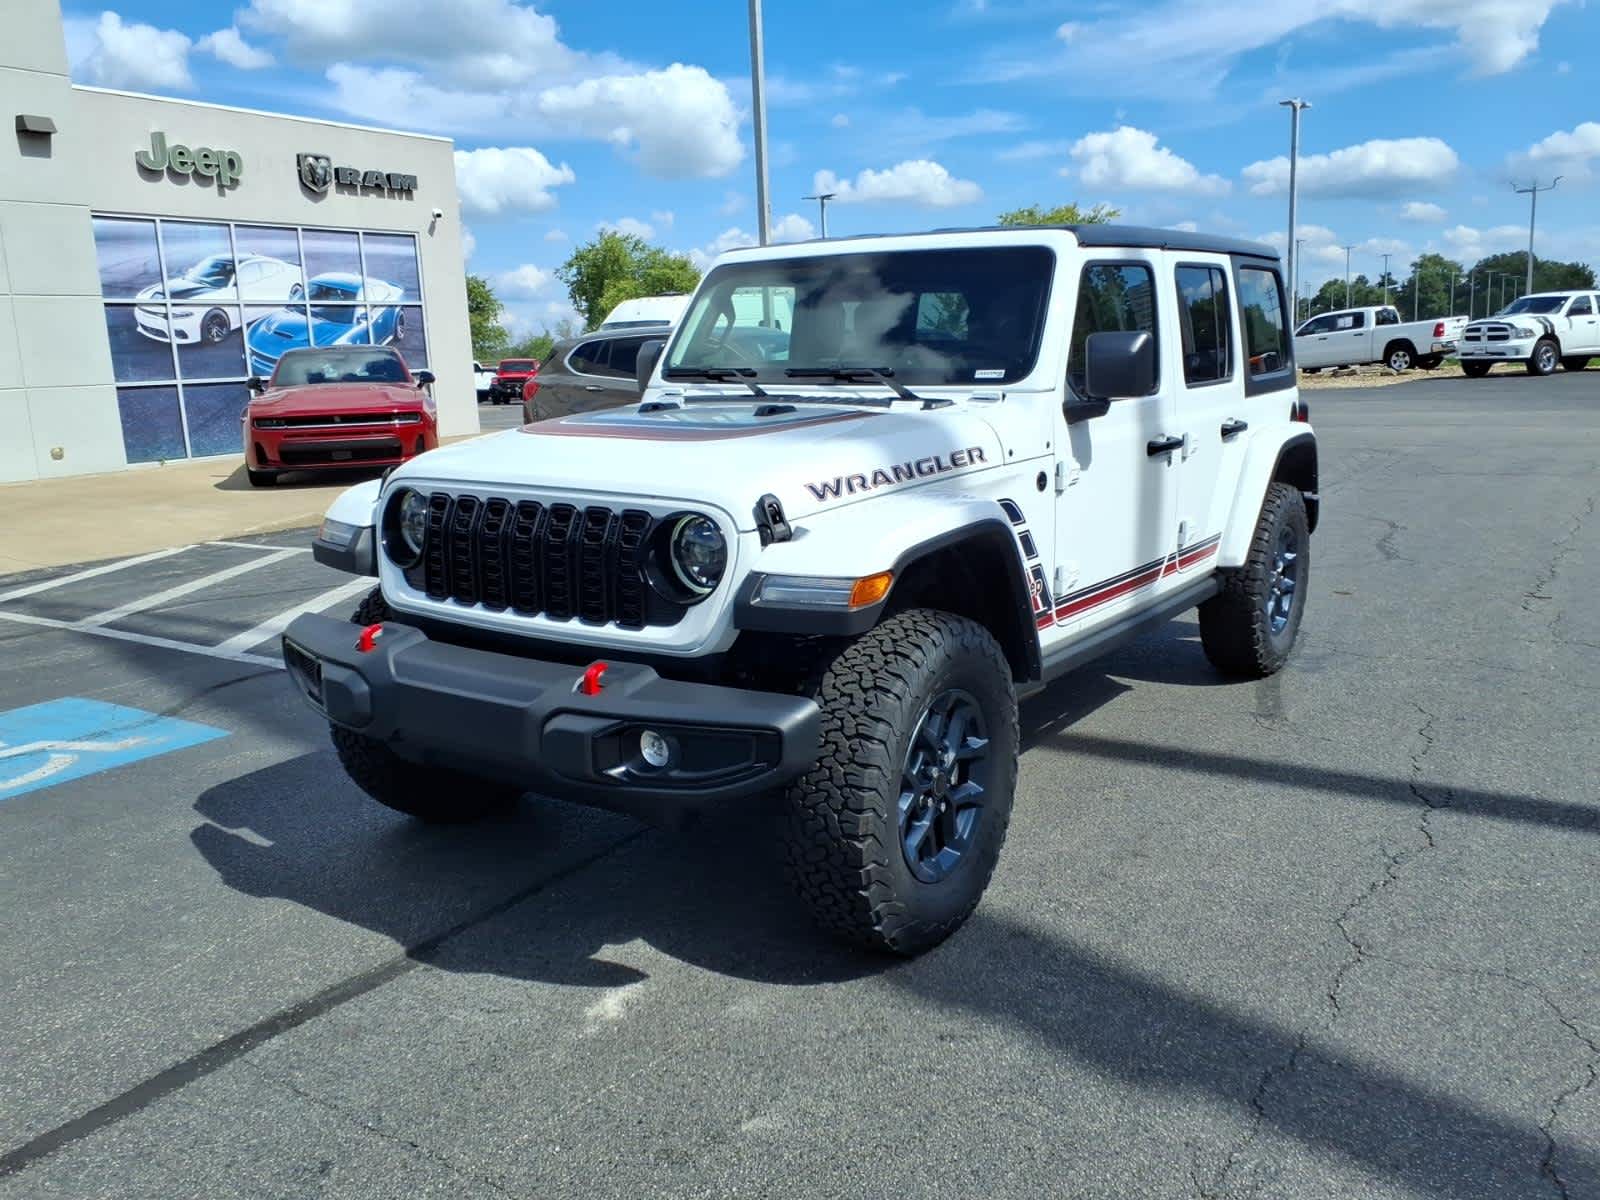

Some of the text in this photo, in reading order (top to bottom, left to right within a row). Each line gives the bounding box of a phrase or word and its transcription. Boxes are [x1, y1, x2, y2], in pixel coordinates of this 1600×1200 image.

[135, 131, 243, 186] Jeep
[335, 166, 418, 191] RAM
[804, 446, 987, 501] WRANGLER
